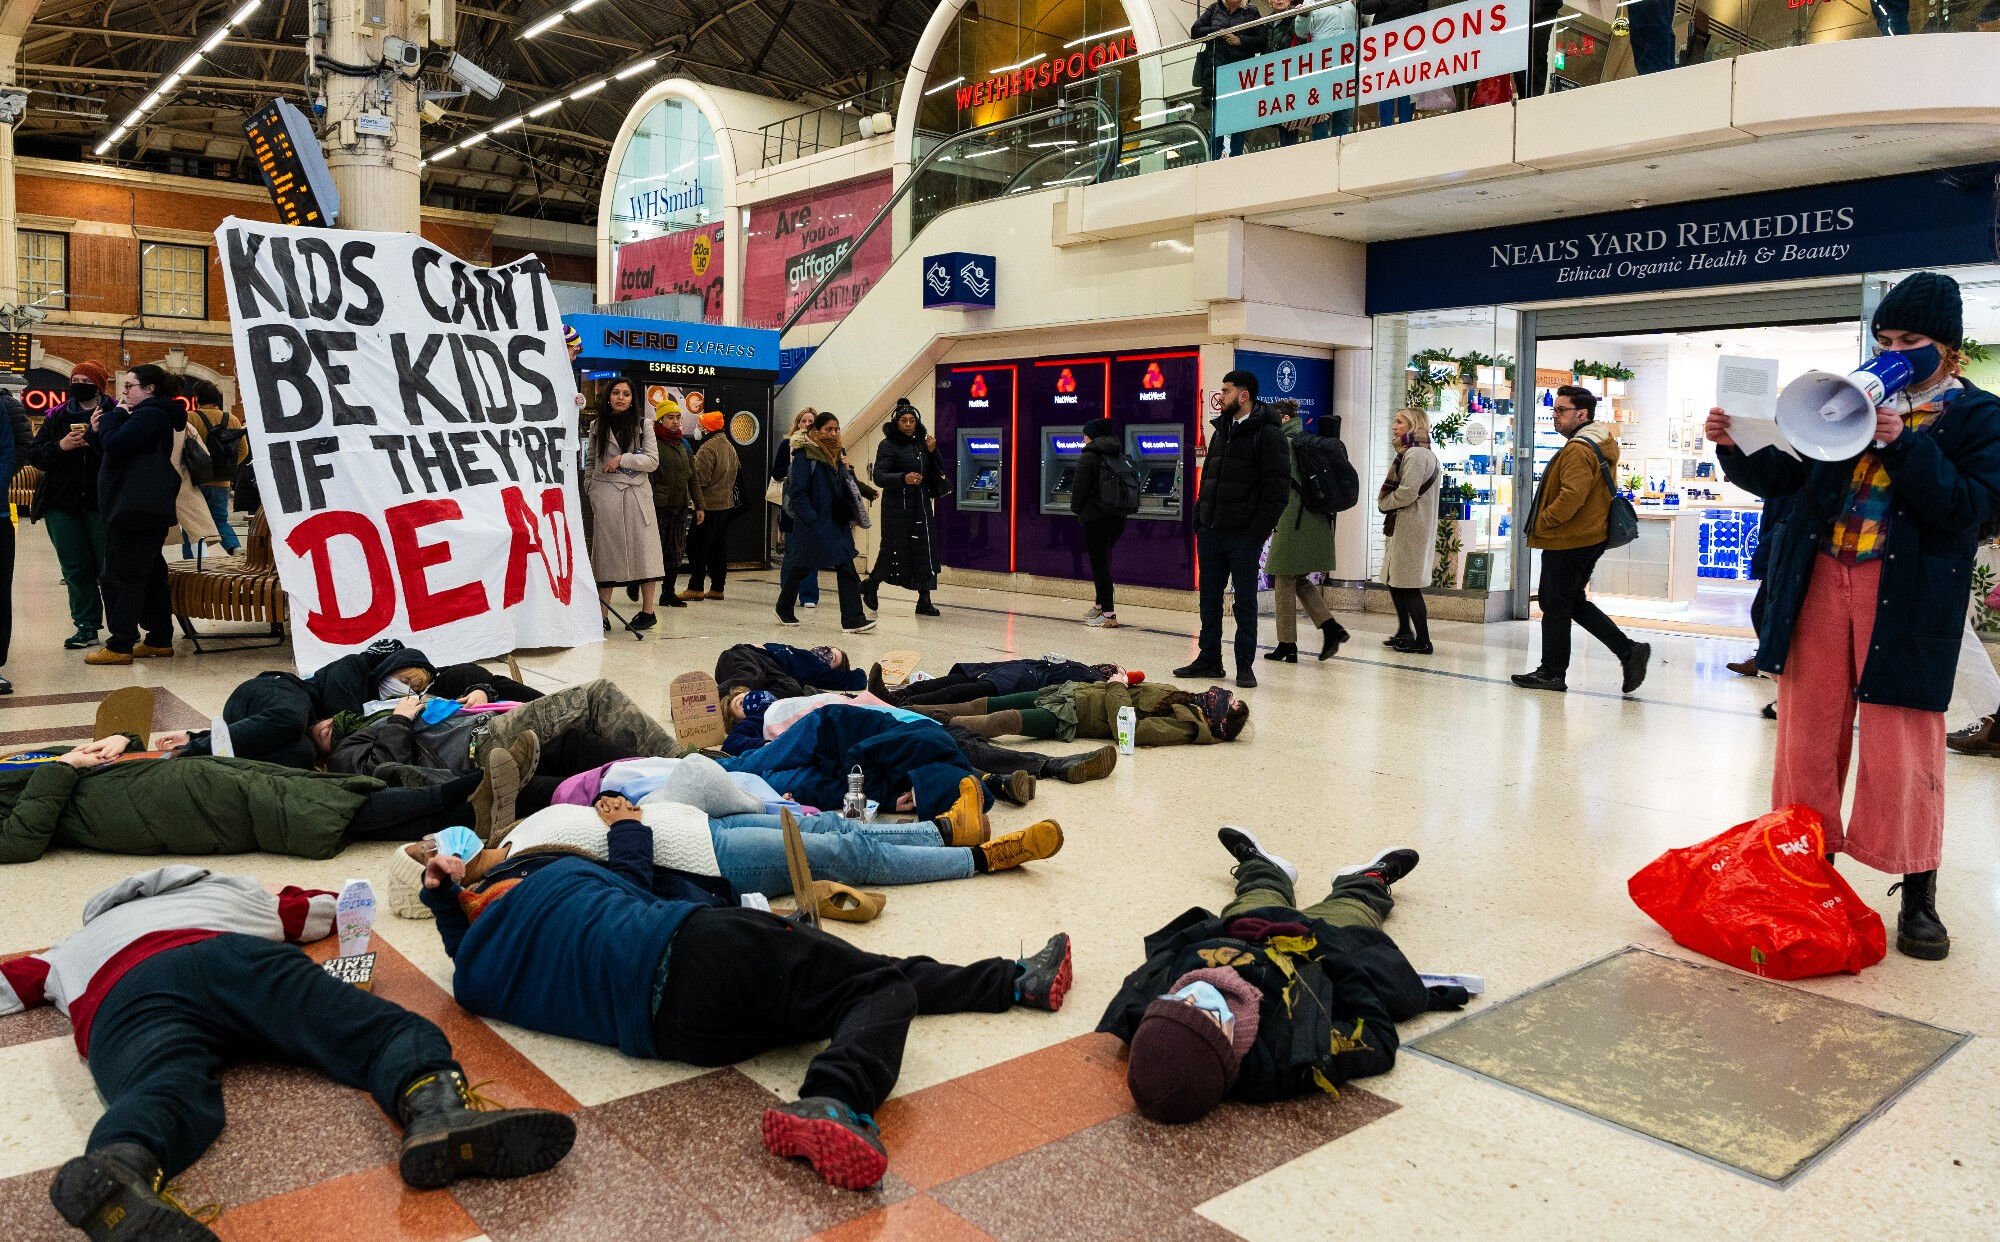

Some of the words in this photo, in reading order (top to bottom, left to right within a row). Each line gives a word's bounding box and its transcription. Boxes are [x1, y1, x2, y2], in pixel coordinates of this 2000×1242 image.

[1238, 4, 1508, 90] WETHERSPOONS
[1257, 93, 1296, 118] BAR
[1307, 87, 1320, 106] &
[1332, 50, 1481, 100] RESTAURANT
[630, 179, 704, 221] WHSmith
[775, 205, 812, 240] Are
[801, 226, 826, 250] you
[828, 225, 840, 237] on
[1490, 239, 1580, 268] NEAL'S
[1587, 229, 1667, 257] YARD
[1676, 207, 1855, 249] REMEDIES
[226, 227, 385, 326] KIDS
[411, 246, 549, 332] CAN'T
[621, 264, 655, 290] total
[789, 241, 849, 292] giffgaff
[1557, 259, 1611, 284] Ethical
[1617, 256, 1682, 278] Organic
[1688, 249, 1747, 271] Health
[1754, 247, 1776, 264] &
[1781, 242, 1850, 262] Beauty
[604, 328, 679, 350] NERO
[684, 339, 756, 358] EXPRESS
[248, 323, 378, 434] BE
[390, 334, 559, 425] KIDS
[649, 362, 695, 375] ESPRESSO
[698, 366, 716, 376] BAR
[968, 399, 989, 408] NatWest
[1054, 395, 1078, 404] NatWest
[1139, 391, 1167, 401] NatWest
[268, 435, 340, 514] IF
[369, 426, 567, 495] THEY'RE
[285, 486, 573, 646] DEAD
[322, 959, 374, 972] KING
